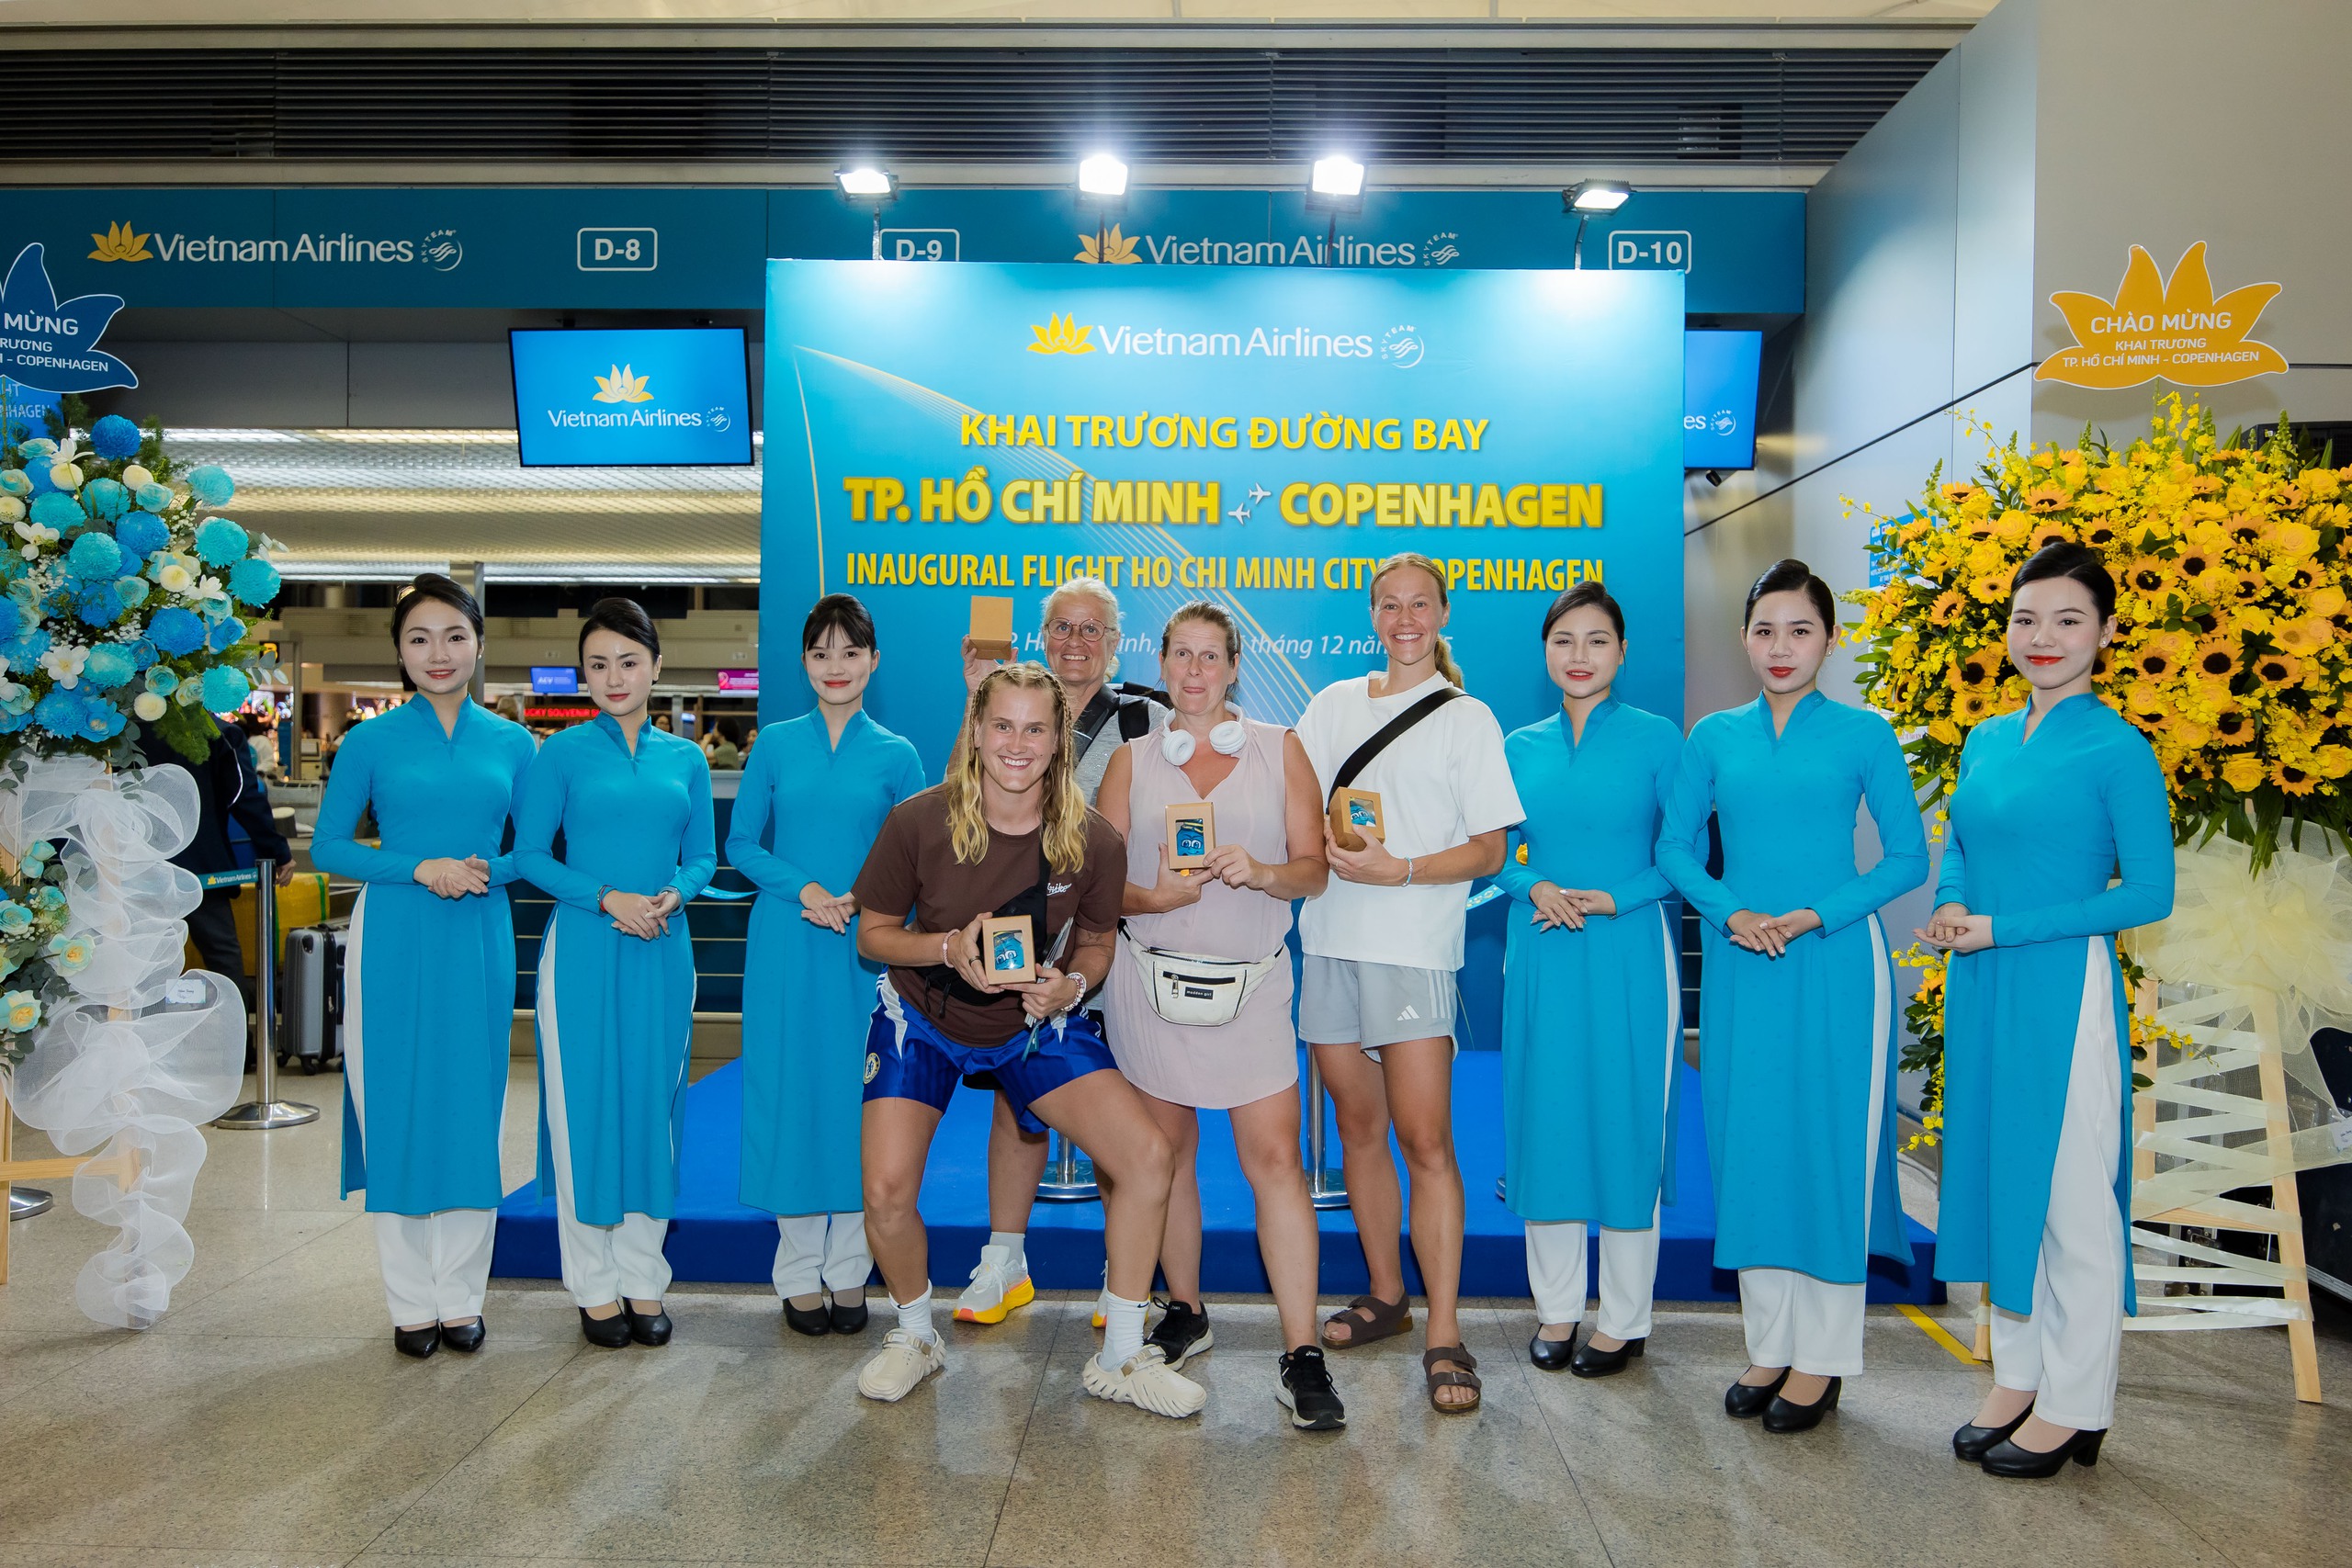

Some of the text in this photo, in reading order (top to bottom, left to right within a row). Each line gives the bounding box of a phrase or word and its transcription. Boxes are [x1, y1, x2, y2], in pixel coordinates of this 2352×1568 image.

[154, 232, 414, 263] Vietnam Airlines
[421, 229, 454, 263] SKYTEAM
[594, 238, 640, 261] D-8
[896, 239, 943, 261] D-9
[1145, 235, 1416, 265] Vietnam Airlines
[1423, 231, 1456, 266] SKYTEAM
[1617, 241, 1682, 264] D-10
[4, 309, 79, 335] MỪNG
[2090, 308, 2232, 333] CHÀO MỪNG
[0, 337, 52, 353] RƯƠNG
[1097, 324, 1374, 358] Vietnam Airlines
[1381, 324, 1415, 360] SKYTEAM
[2115, 337, 2207, 351] KHAI TRƯƠNG
[17, 354, 108, 372] COPENHAGEN
[2063, 356, 2078, 367] TP.
[2103, 353, 2125, 367] CHÍ
[2127, 354, 2160, 365] MINH
[2172, 351, 2259, 364] COPENHAGEN
[548, 409, 702, 427] Vietnam Airlines
[960, 411, 1489, 451] KHAI TRƯƠNG ĐƯỜNG BAY
[842, 465, 1603, 528] TP. HỒ CHÍ MINH COPENHAGEN
[846, 553, 1015, 587] INAUGURAL
[1022, 555, 1125, 587] FLIGHT
[1131, 556, 1172, 588] HO
[1179, 556, 1227, 589] CHI
[1235, 557, 1316, 590] MINH
[1430, 558, 1603, 591] PENHAGEN
[1024, 632, 1045, 651] H
[1118, 632, 1157, 656] inh,
[1250, 634, 1313, 659] tháng
[1321, 635, 1345, 655] 12
[524, 708, 547, 717] UCKY
[548, 708, 591, 717] SOUVENIR
